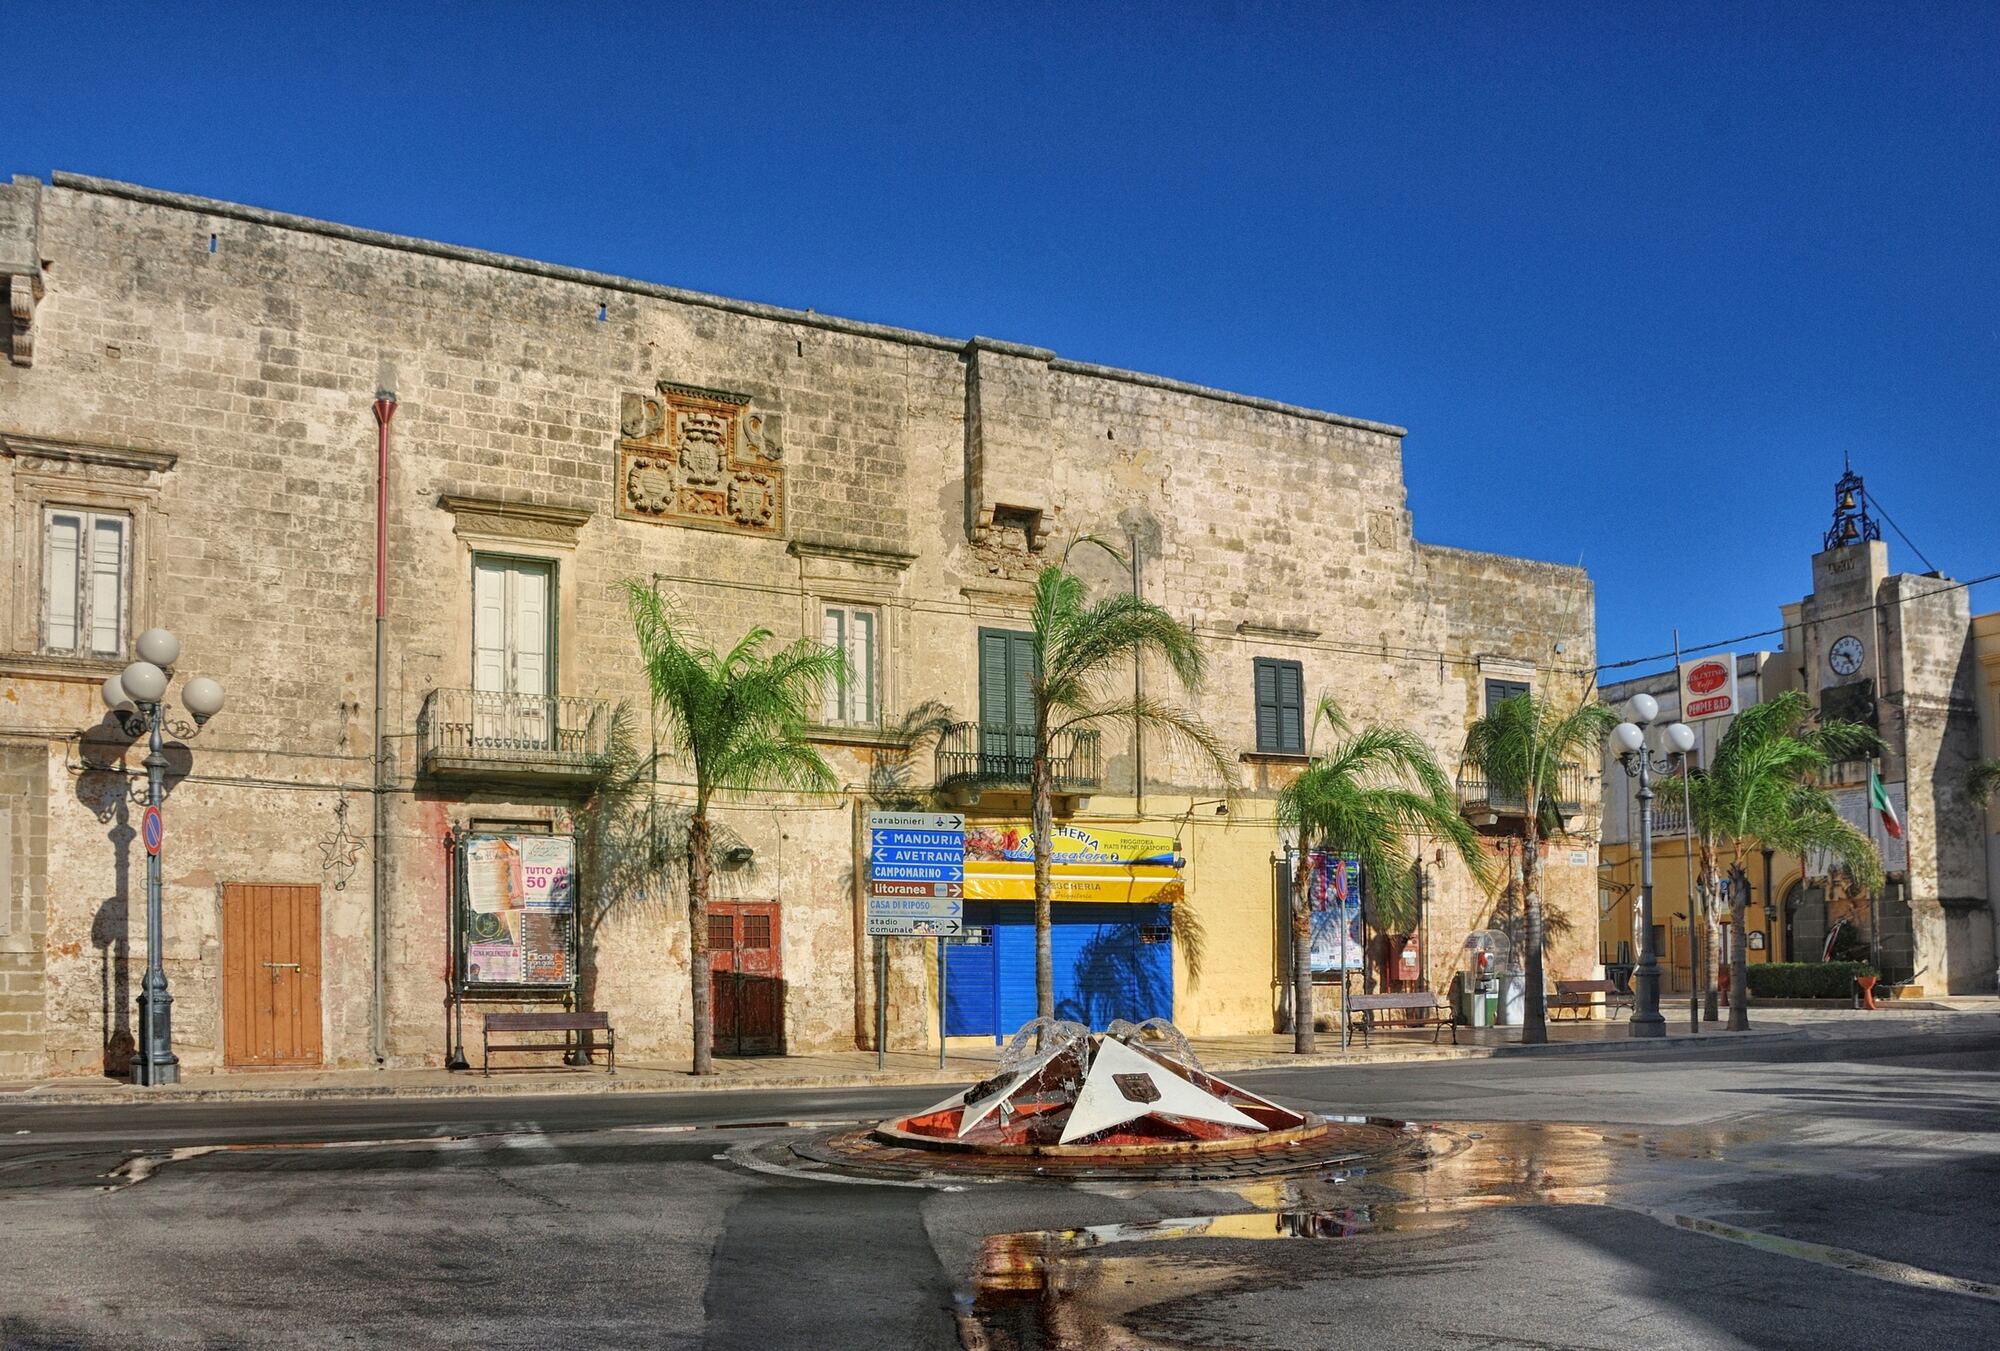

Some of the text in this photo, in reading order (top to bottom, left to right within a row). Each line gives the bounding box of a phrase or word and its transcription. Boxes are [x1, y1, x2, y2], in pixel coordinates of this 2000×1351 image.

[1688, 697, 1729, 716] PEOPLE BAR
[871, 816, 925, 825] carabinieri
[894, 833, 962, 845] MANDURIA
[895, 851, 962, 862] AVETRANA
[525, 866, 553, 875] TUTTO
[874, 866, 941, 878] CAMPOMARINO
[526, 876, 547, 889] 50
[1051, 882, 1102, 891] ESCHERIA
[874, 883, 927, 894] litoranea
[870, 900, 930, 910] CASA DI RIPOSO
